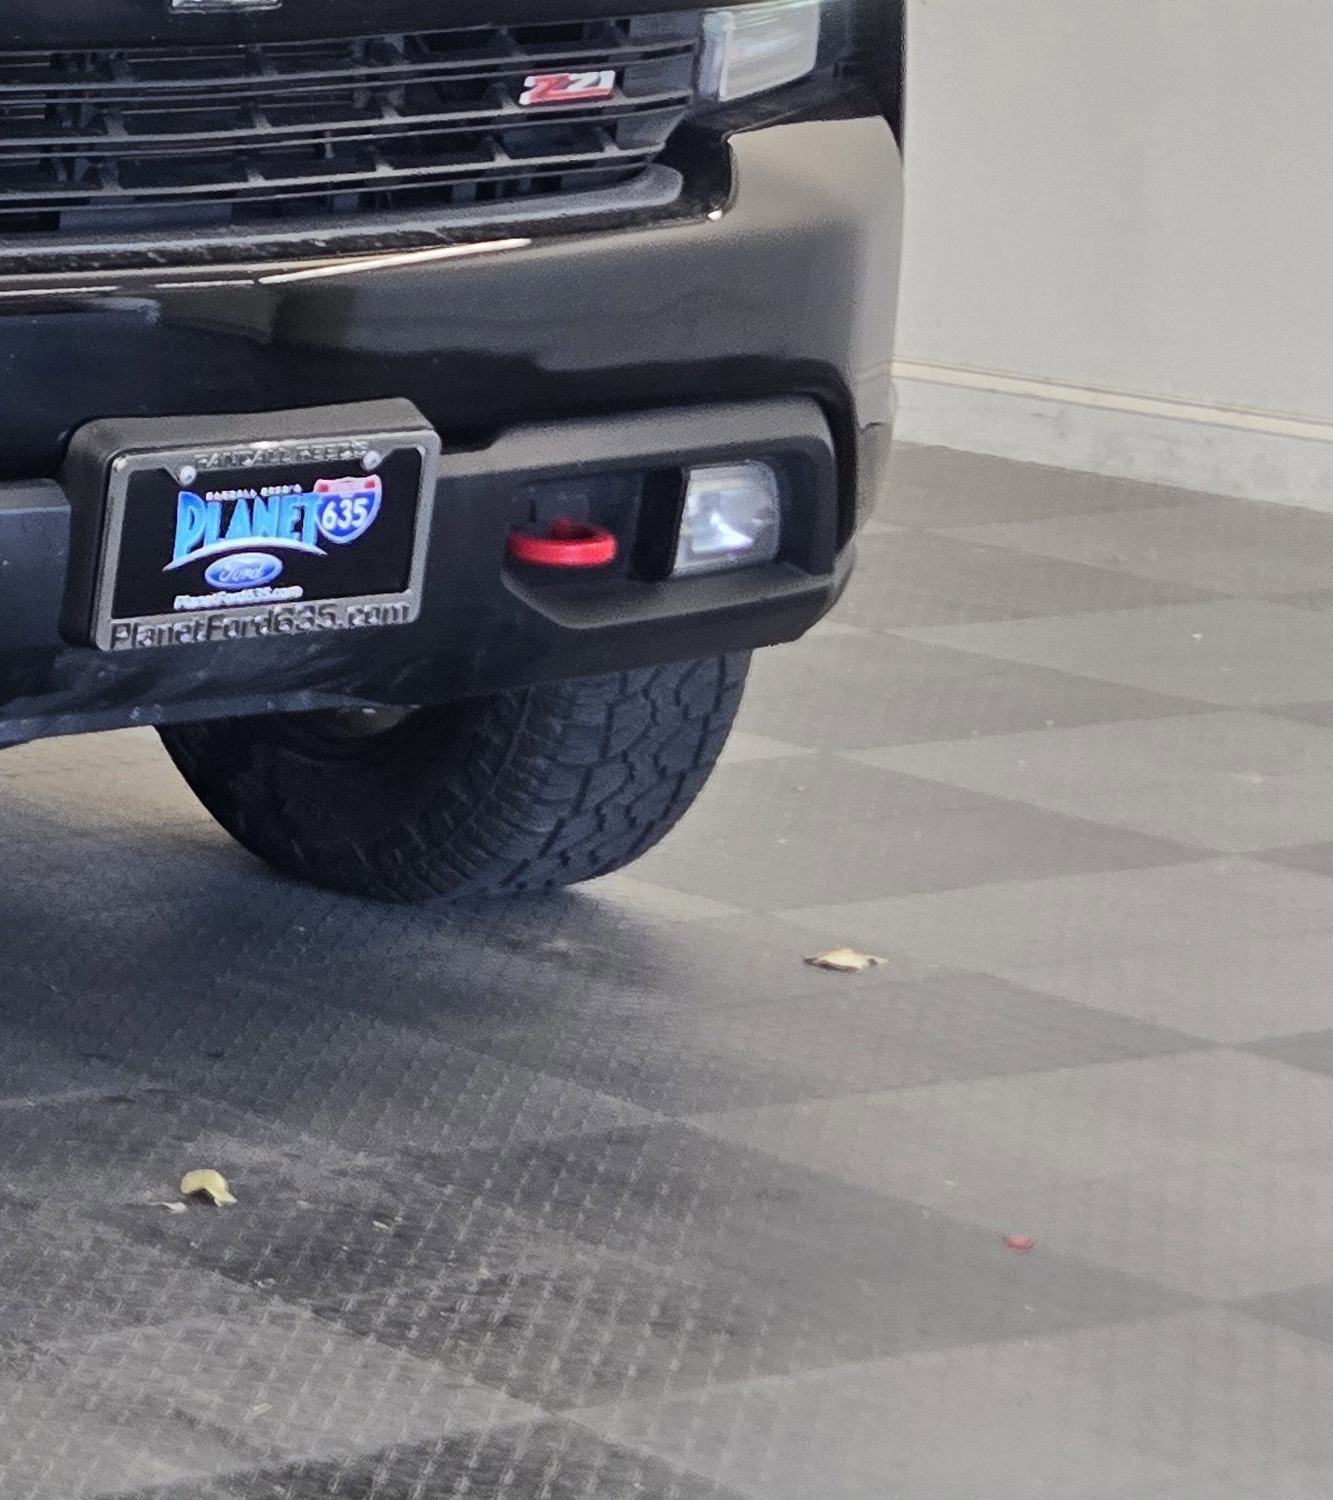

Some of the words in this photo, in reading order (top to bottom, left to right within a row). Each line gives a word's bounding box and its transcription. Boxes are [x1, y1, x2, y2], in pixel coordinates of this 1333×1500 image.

[173, 490, 323, 561] PLANET
[322, 497, 369, 531] 635
[109, 602, 410, 650] PlanetFord635.com
